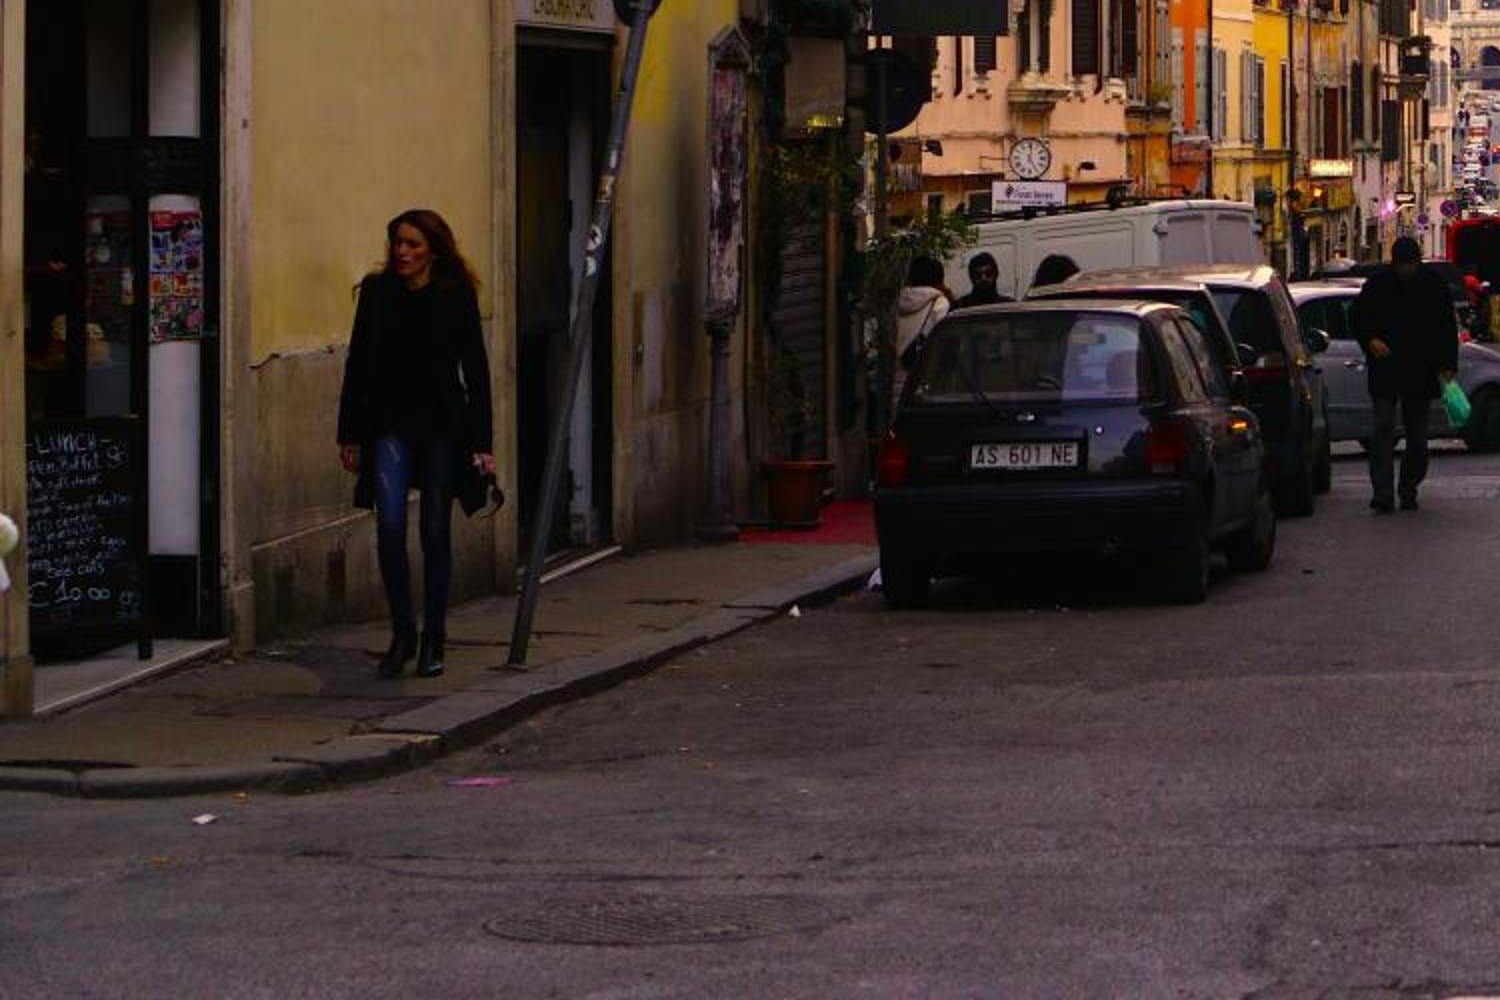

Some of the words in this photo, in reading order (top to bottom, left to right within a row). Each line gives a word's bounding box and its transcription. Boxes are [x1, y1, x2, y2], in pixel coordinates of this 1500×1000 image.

[975, 446, 999, 465] AS
[1008, 445, 1041, 465] 601
[1051, 444, 1073, 464] NE
